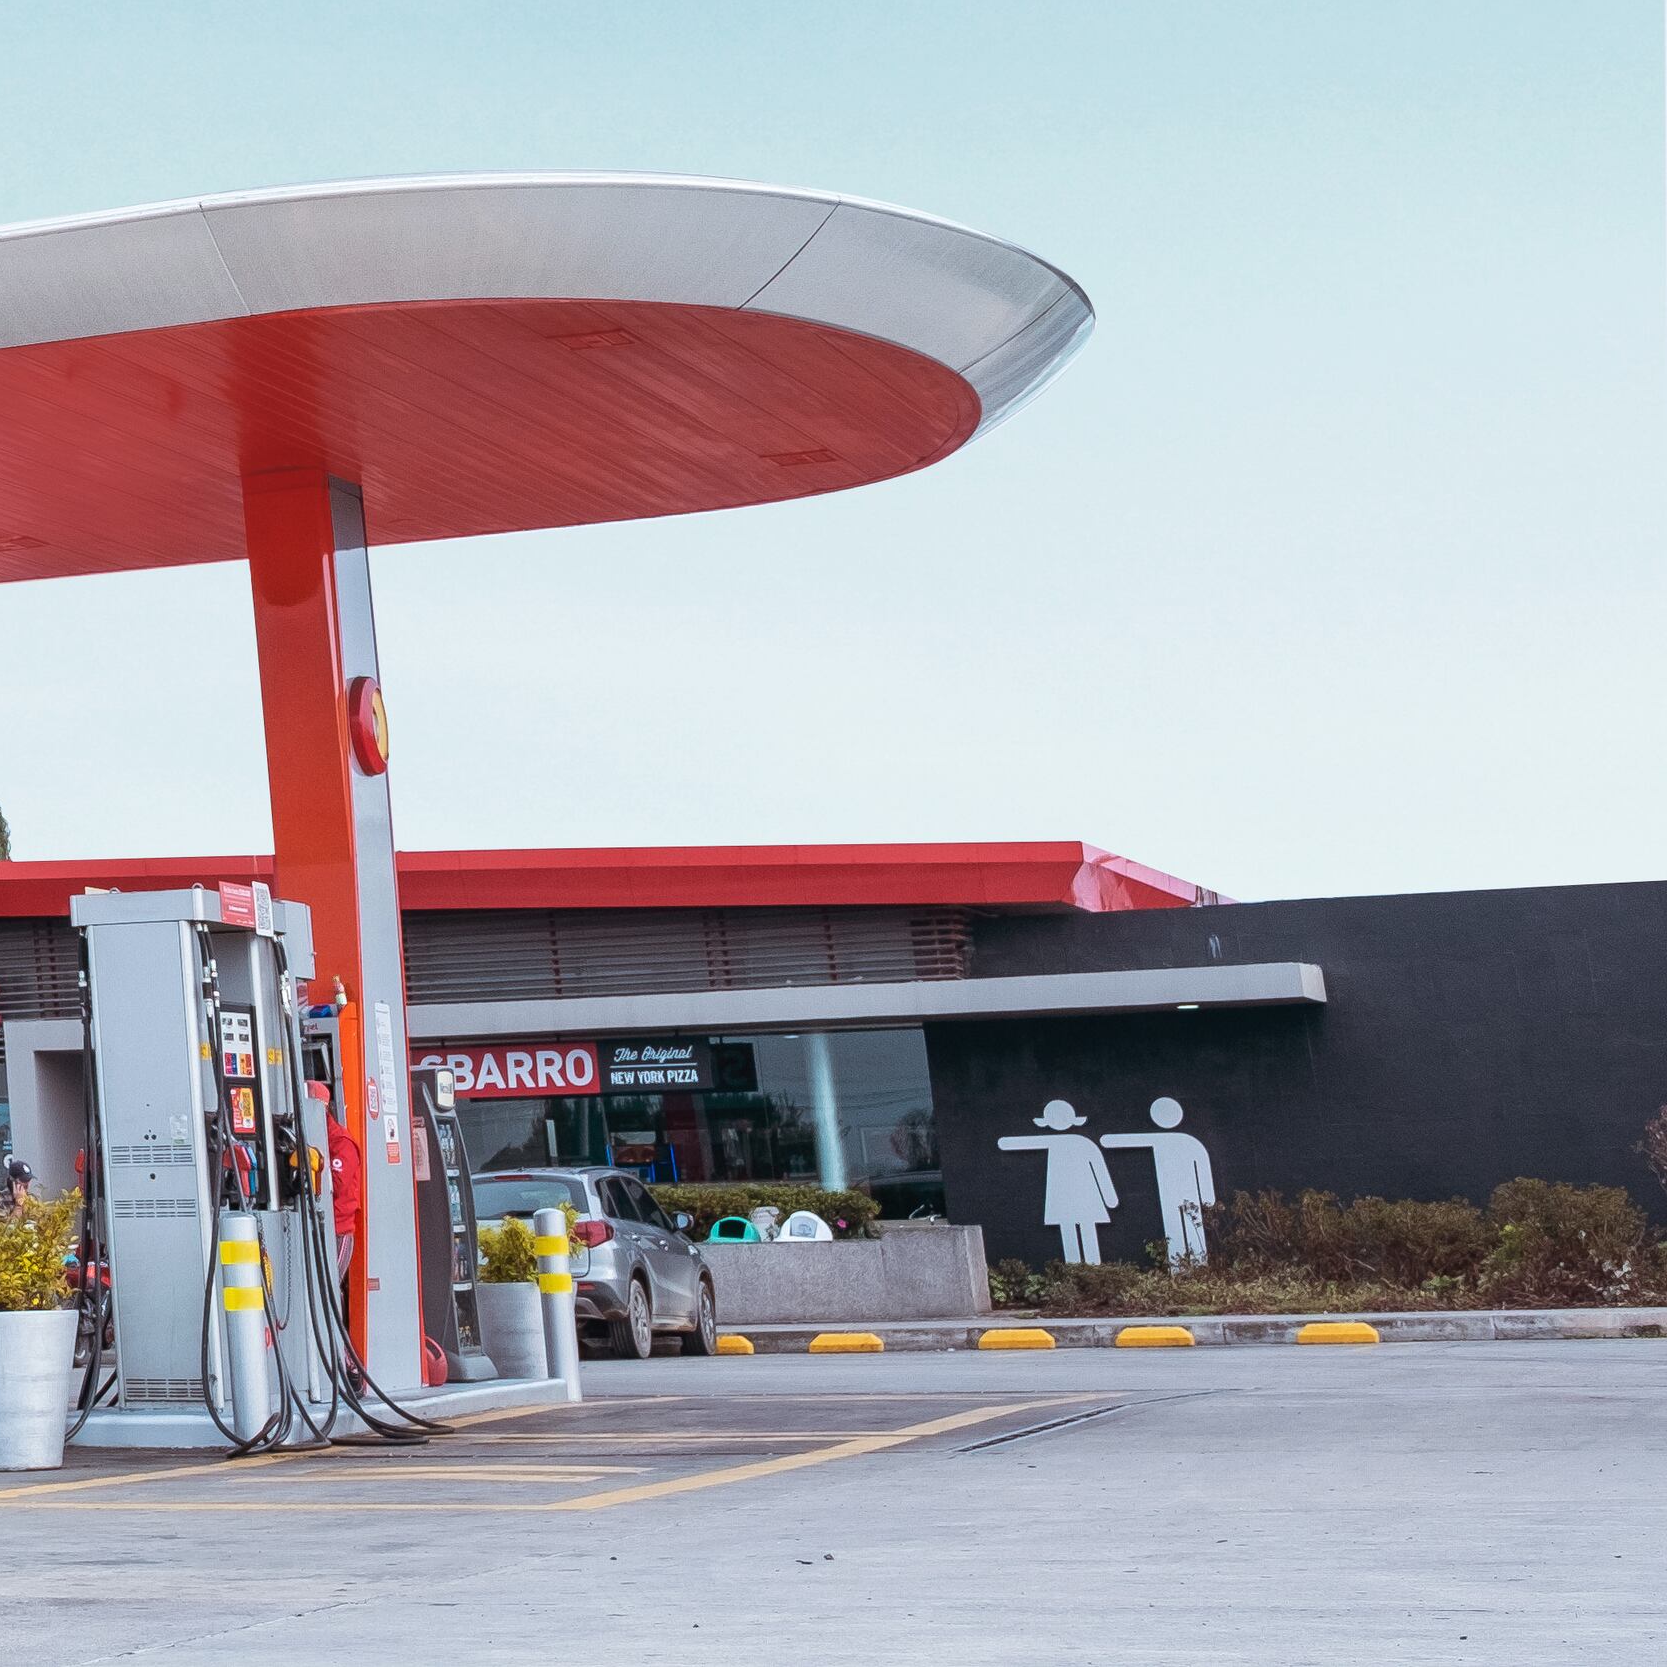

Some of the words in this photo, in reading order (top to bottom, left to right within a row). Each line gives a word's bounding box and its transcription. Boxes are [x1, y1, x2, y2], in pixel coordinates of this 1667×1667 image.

[613, 1047, 639, 1062] The
[641, 1044, 693, 1063] Original
[610, 1070, 635, 1085] NEW
[637, 1069, 666, 1084] YORK
[667, 1068, 699, 1083] PIZZA
